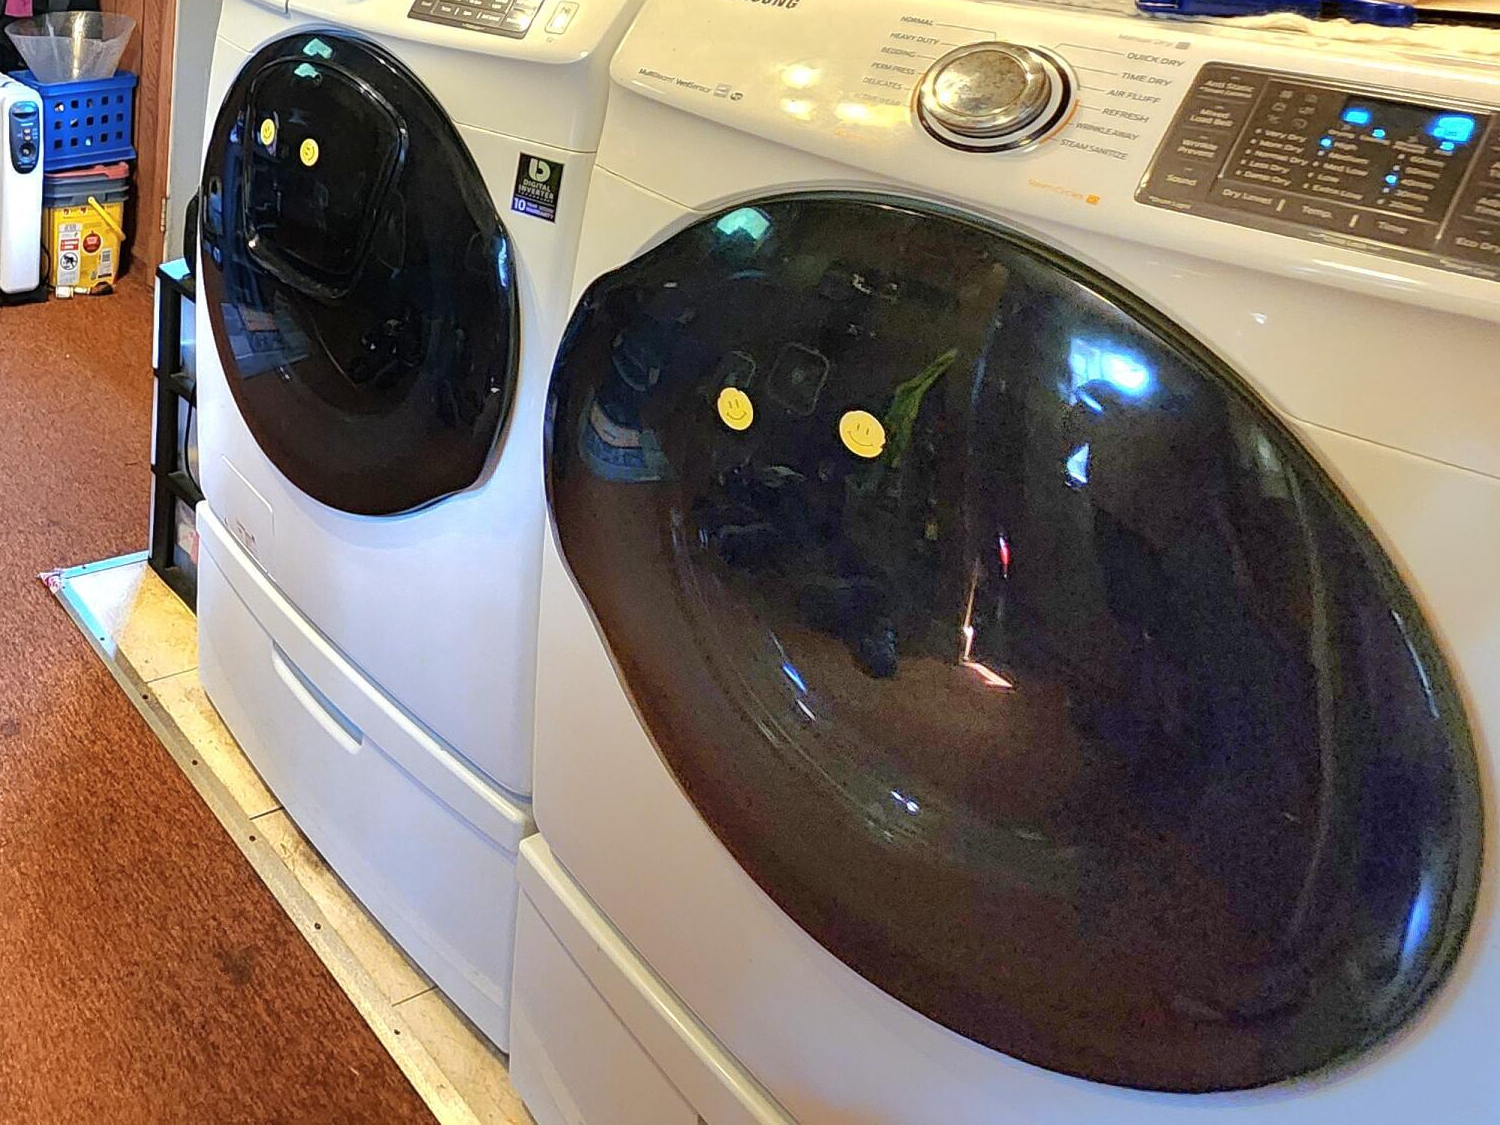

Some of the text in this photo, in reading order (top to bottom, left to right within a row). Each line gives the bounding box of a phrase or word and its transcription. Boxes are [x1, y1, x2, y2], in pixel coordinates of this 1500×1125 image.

[900, 15, 934, 27] NORMAL
[889, 32, 941, 46] HEAVY DUTY
[880, 46, 917, 58] BEDDING
[1126, 52, 1186, 67] QUICK DRY
[870, 61, 916, 76] PERM PRESS
[861, 75, 903, 90] DELICATES
[1121, 71, 1173, 87] TIME DRY
[1203, 79, 1225, 89] Anti
[1105, 89, 1162, 104] AIR FLUFF
[1101, 107, 1150, 123] REFRESH
[1287, 133, 1308, 143] Dry
[1060, 138, 1130, 161] STEAM SANITIZE
[1283, 143, 1305, 154] Dry
[1288, 155, 1309, 167] Dry
[1269, 163, 1291, 174] Dry
[522, 178, 551, 193] DIGITAL
[1165, 173, 1198, 186] Sound
[1271, 175, 1292, 186] Dry
[518, 183, 554, 200] INVERTER
[1222, 188, 1242, 199] Dry
[513, 196, 527, 211] 10
